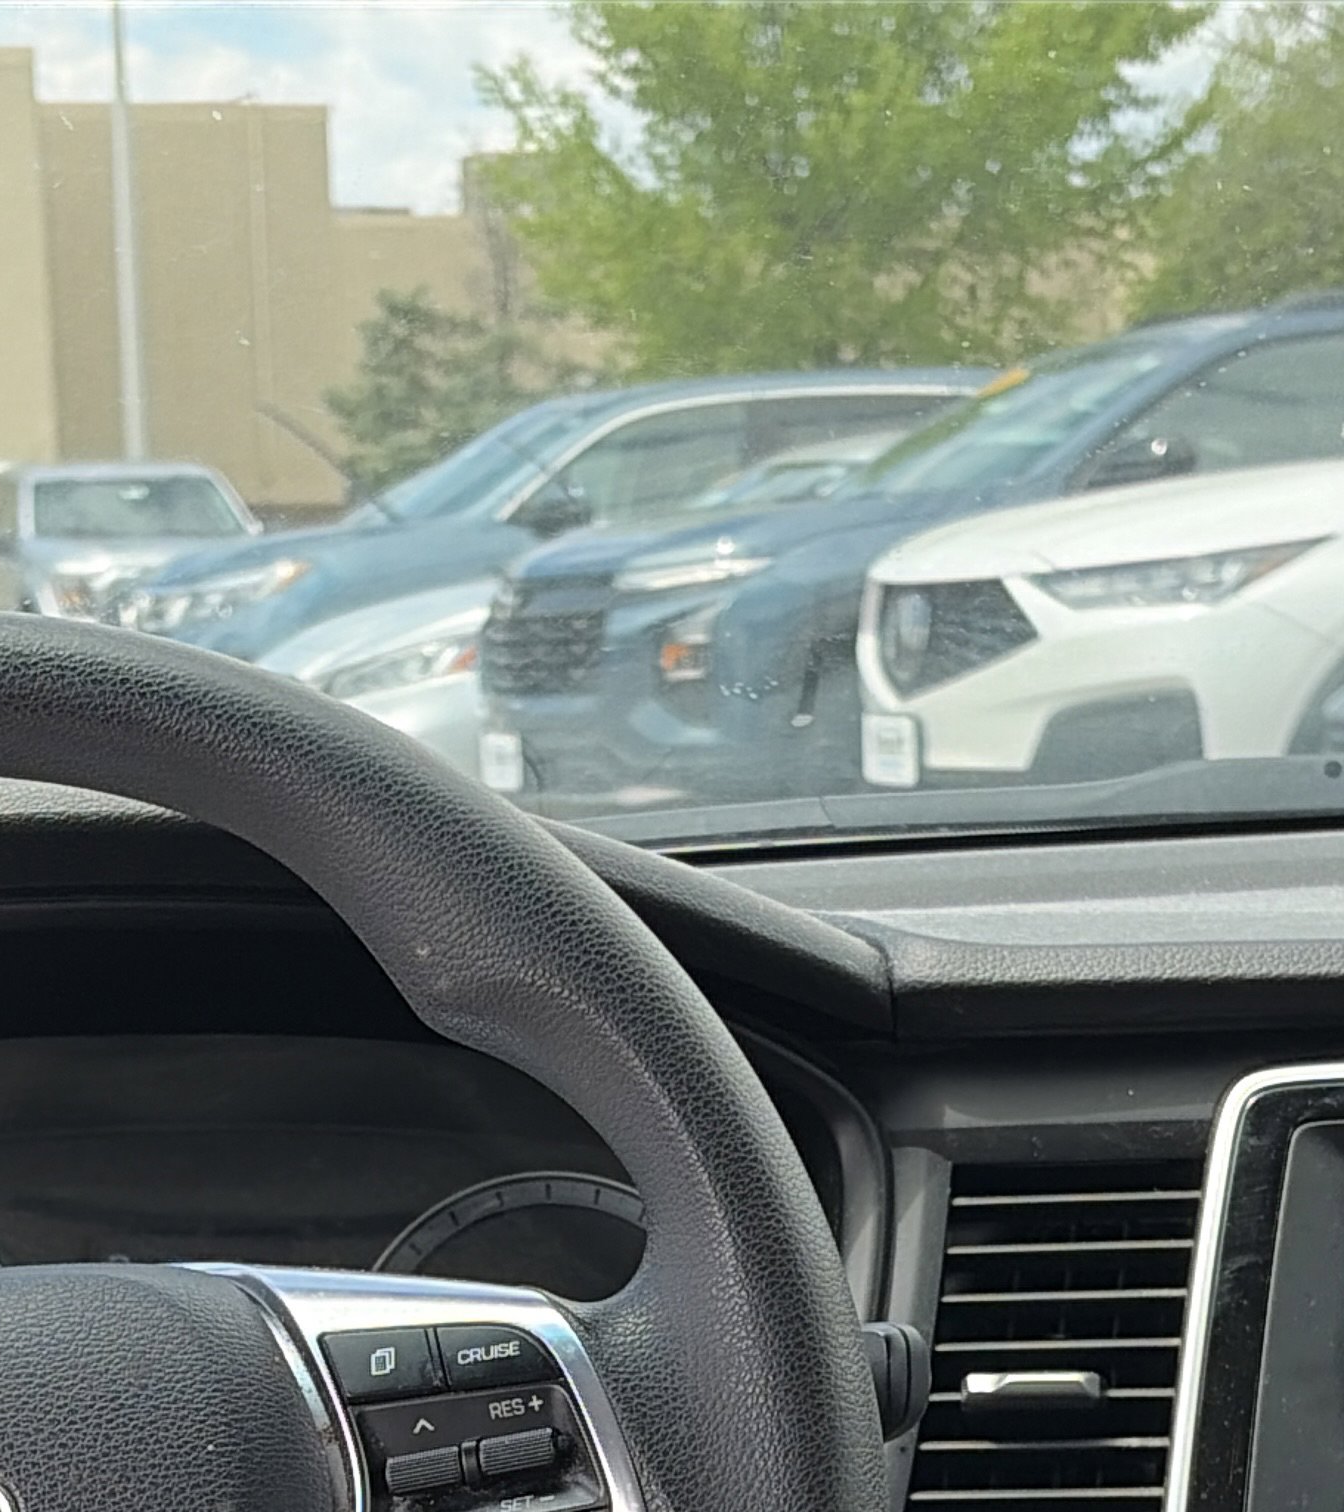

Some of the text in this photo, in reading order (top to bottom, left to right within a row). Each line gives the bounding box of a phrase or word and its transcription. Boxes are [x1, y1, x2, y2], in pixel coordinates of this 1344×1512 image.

[457, 1342, 521, 1366] CRUISE
[489, 1401, 526, 1420] RES
[499, 1496, 533, 1512] SET
